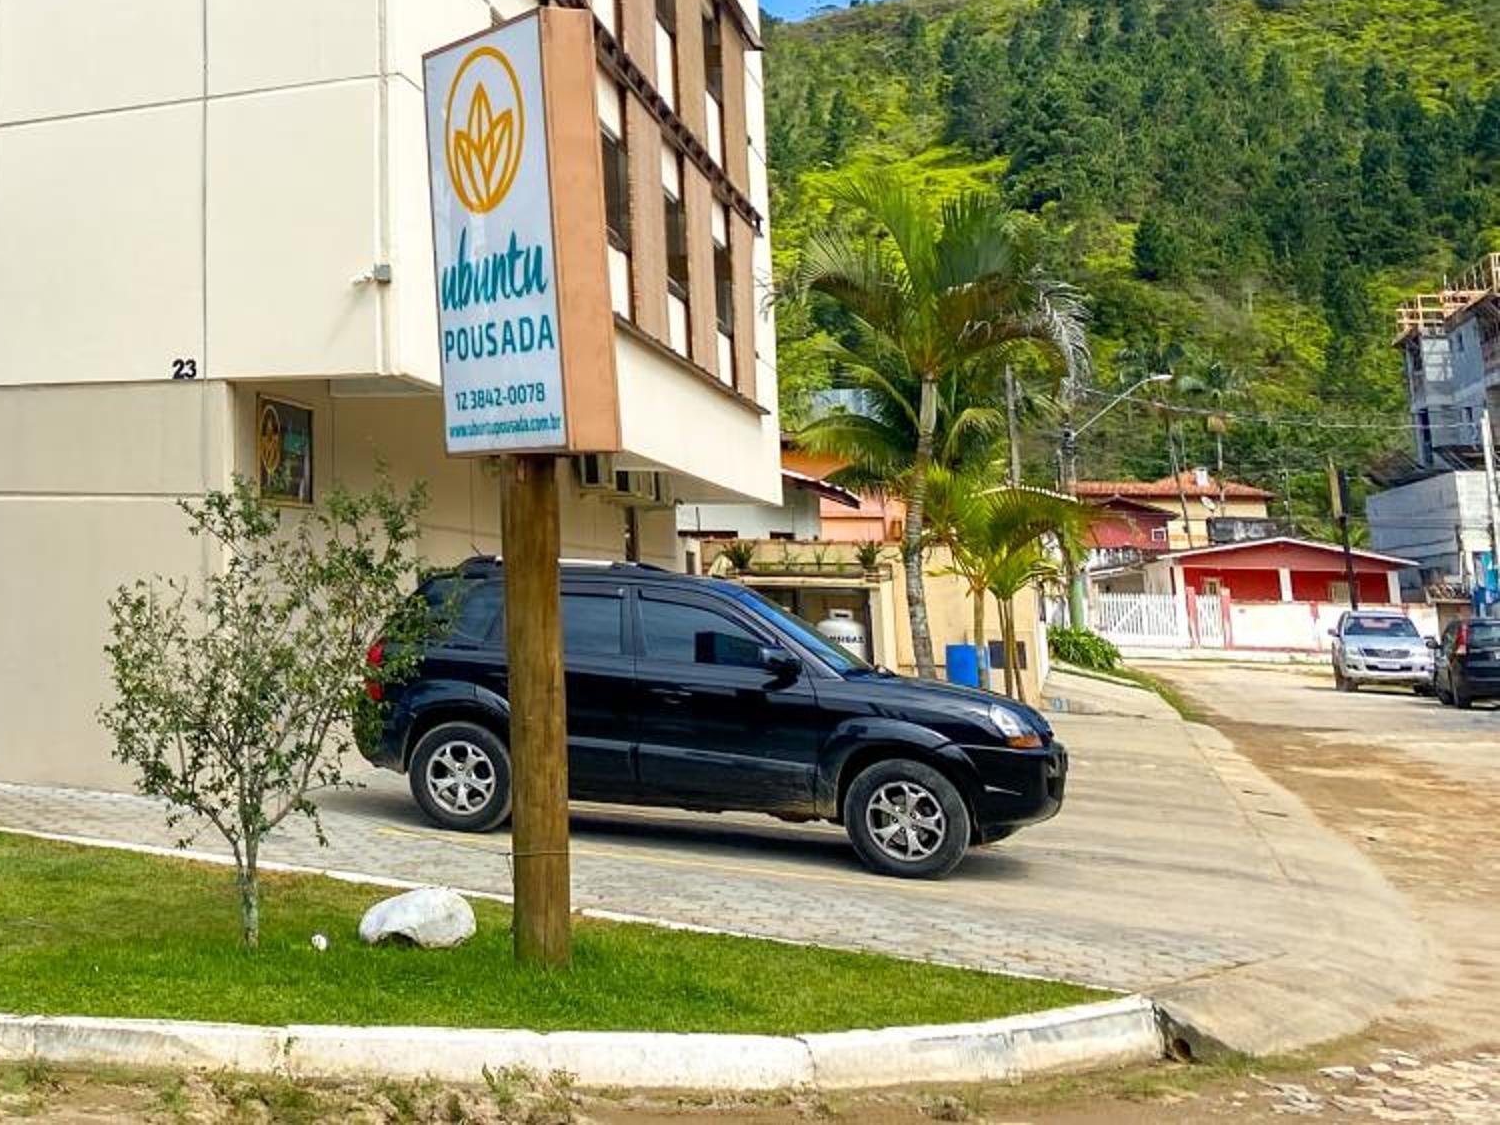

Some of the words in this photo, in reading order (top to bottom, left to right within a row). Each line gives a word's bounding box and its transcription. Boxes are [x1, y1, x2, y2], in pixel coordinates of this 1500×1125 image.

[442, 227, 548, 311] ubuntu
[444, 314, 555, 363] POUSADA
[172, 358, 197, 380] 23
[455, 391, 468, 412] 12
[470, 382, 545, 409] 3842-0078
